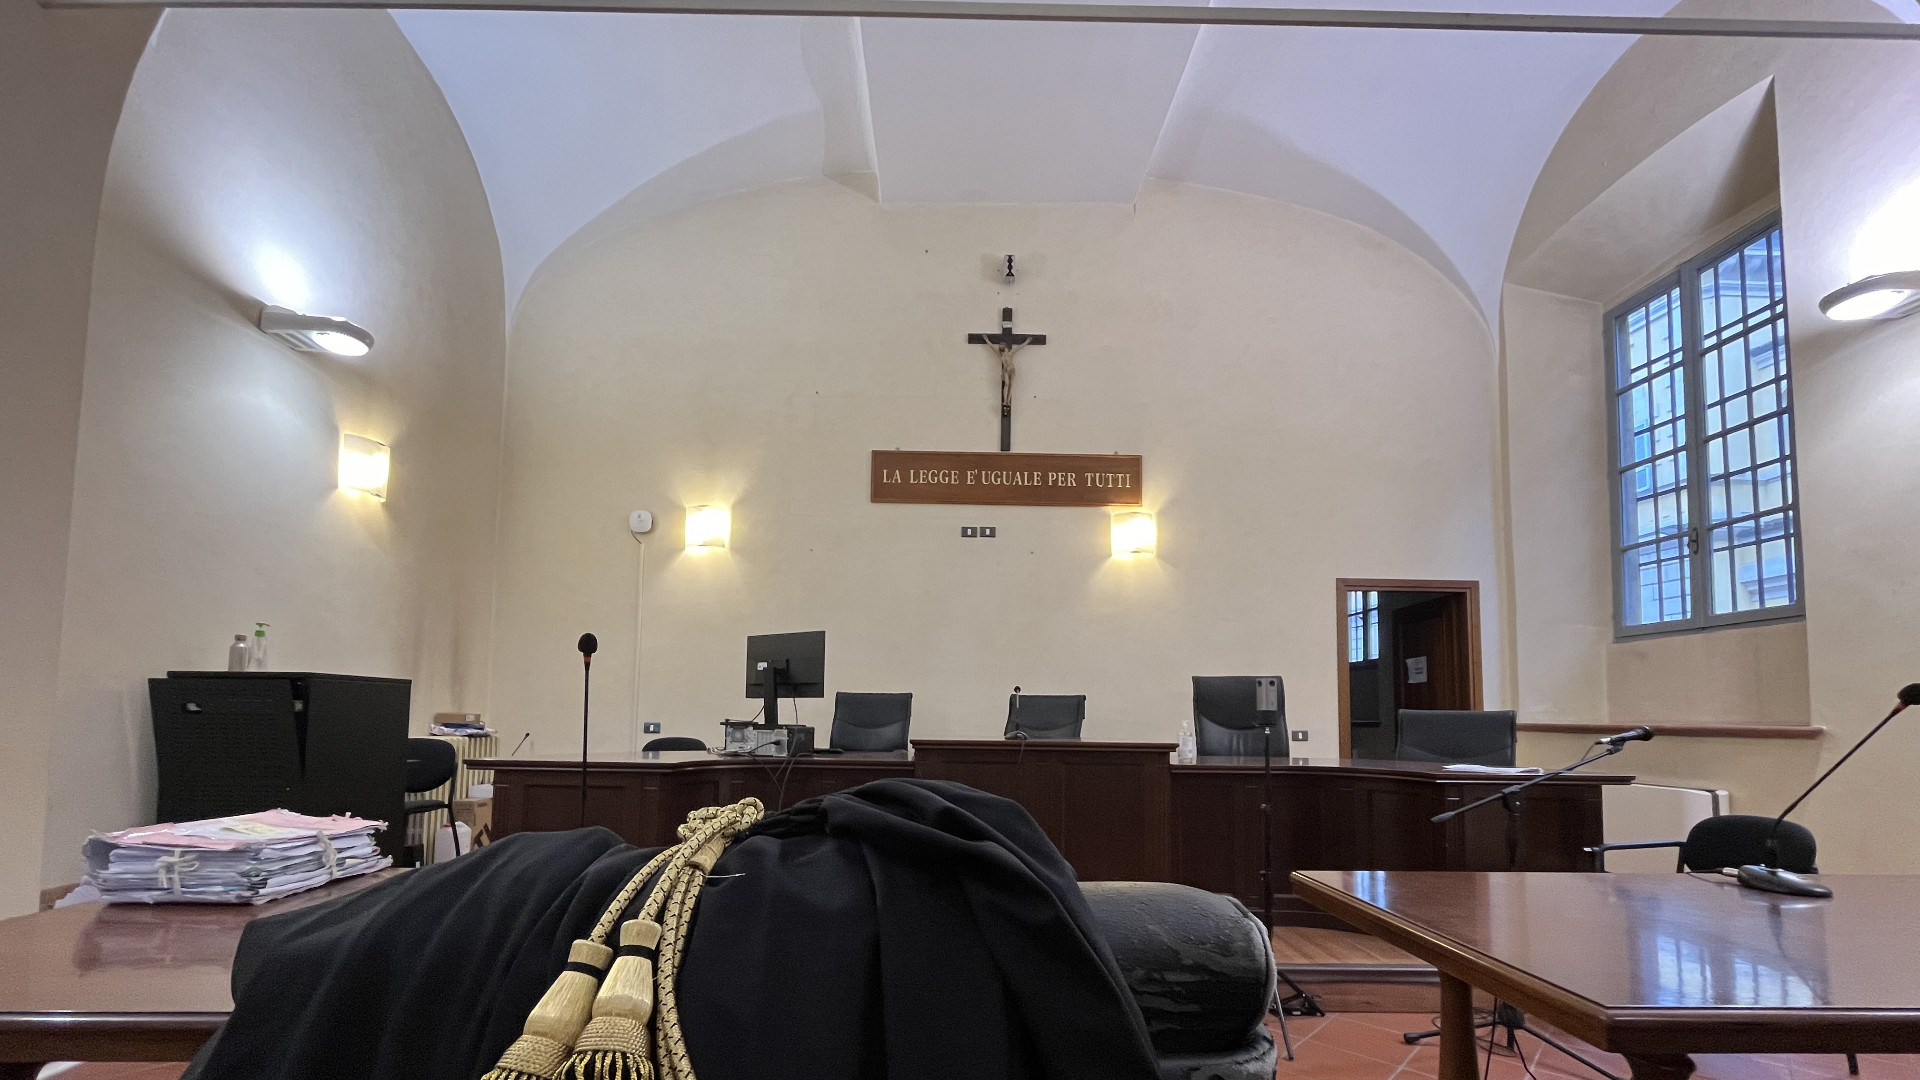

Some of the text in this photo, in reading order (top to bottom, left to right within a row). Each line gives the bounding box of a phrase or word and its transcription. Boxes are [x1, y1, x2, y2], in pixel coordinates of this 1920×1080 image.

[882, 469, 902, 484] LA
[909, 469, 959, 485] LEGGE
[1048, 472, 1077, 487] PER
[1085, 472, 1131, 488] TUTTI
